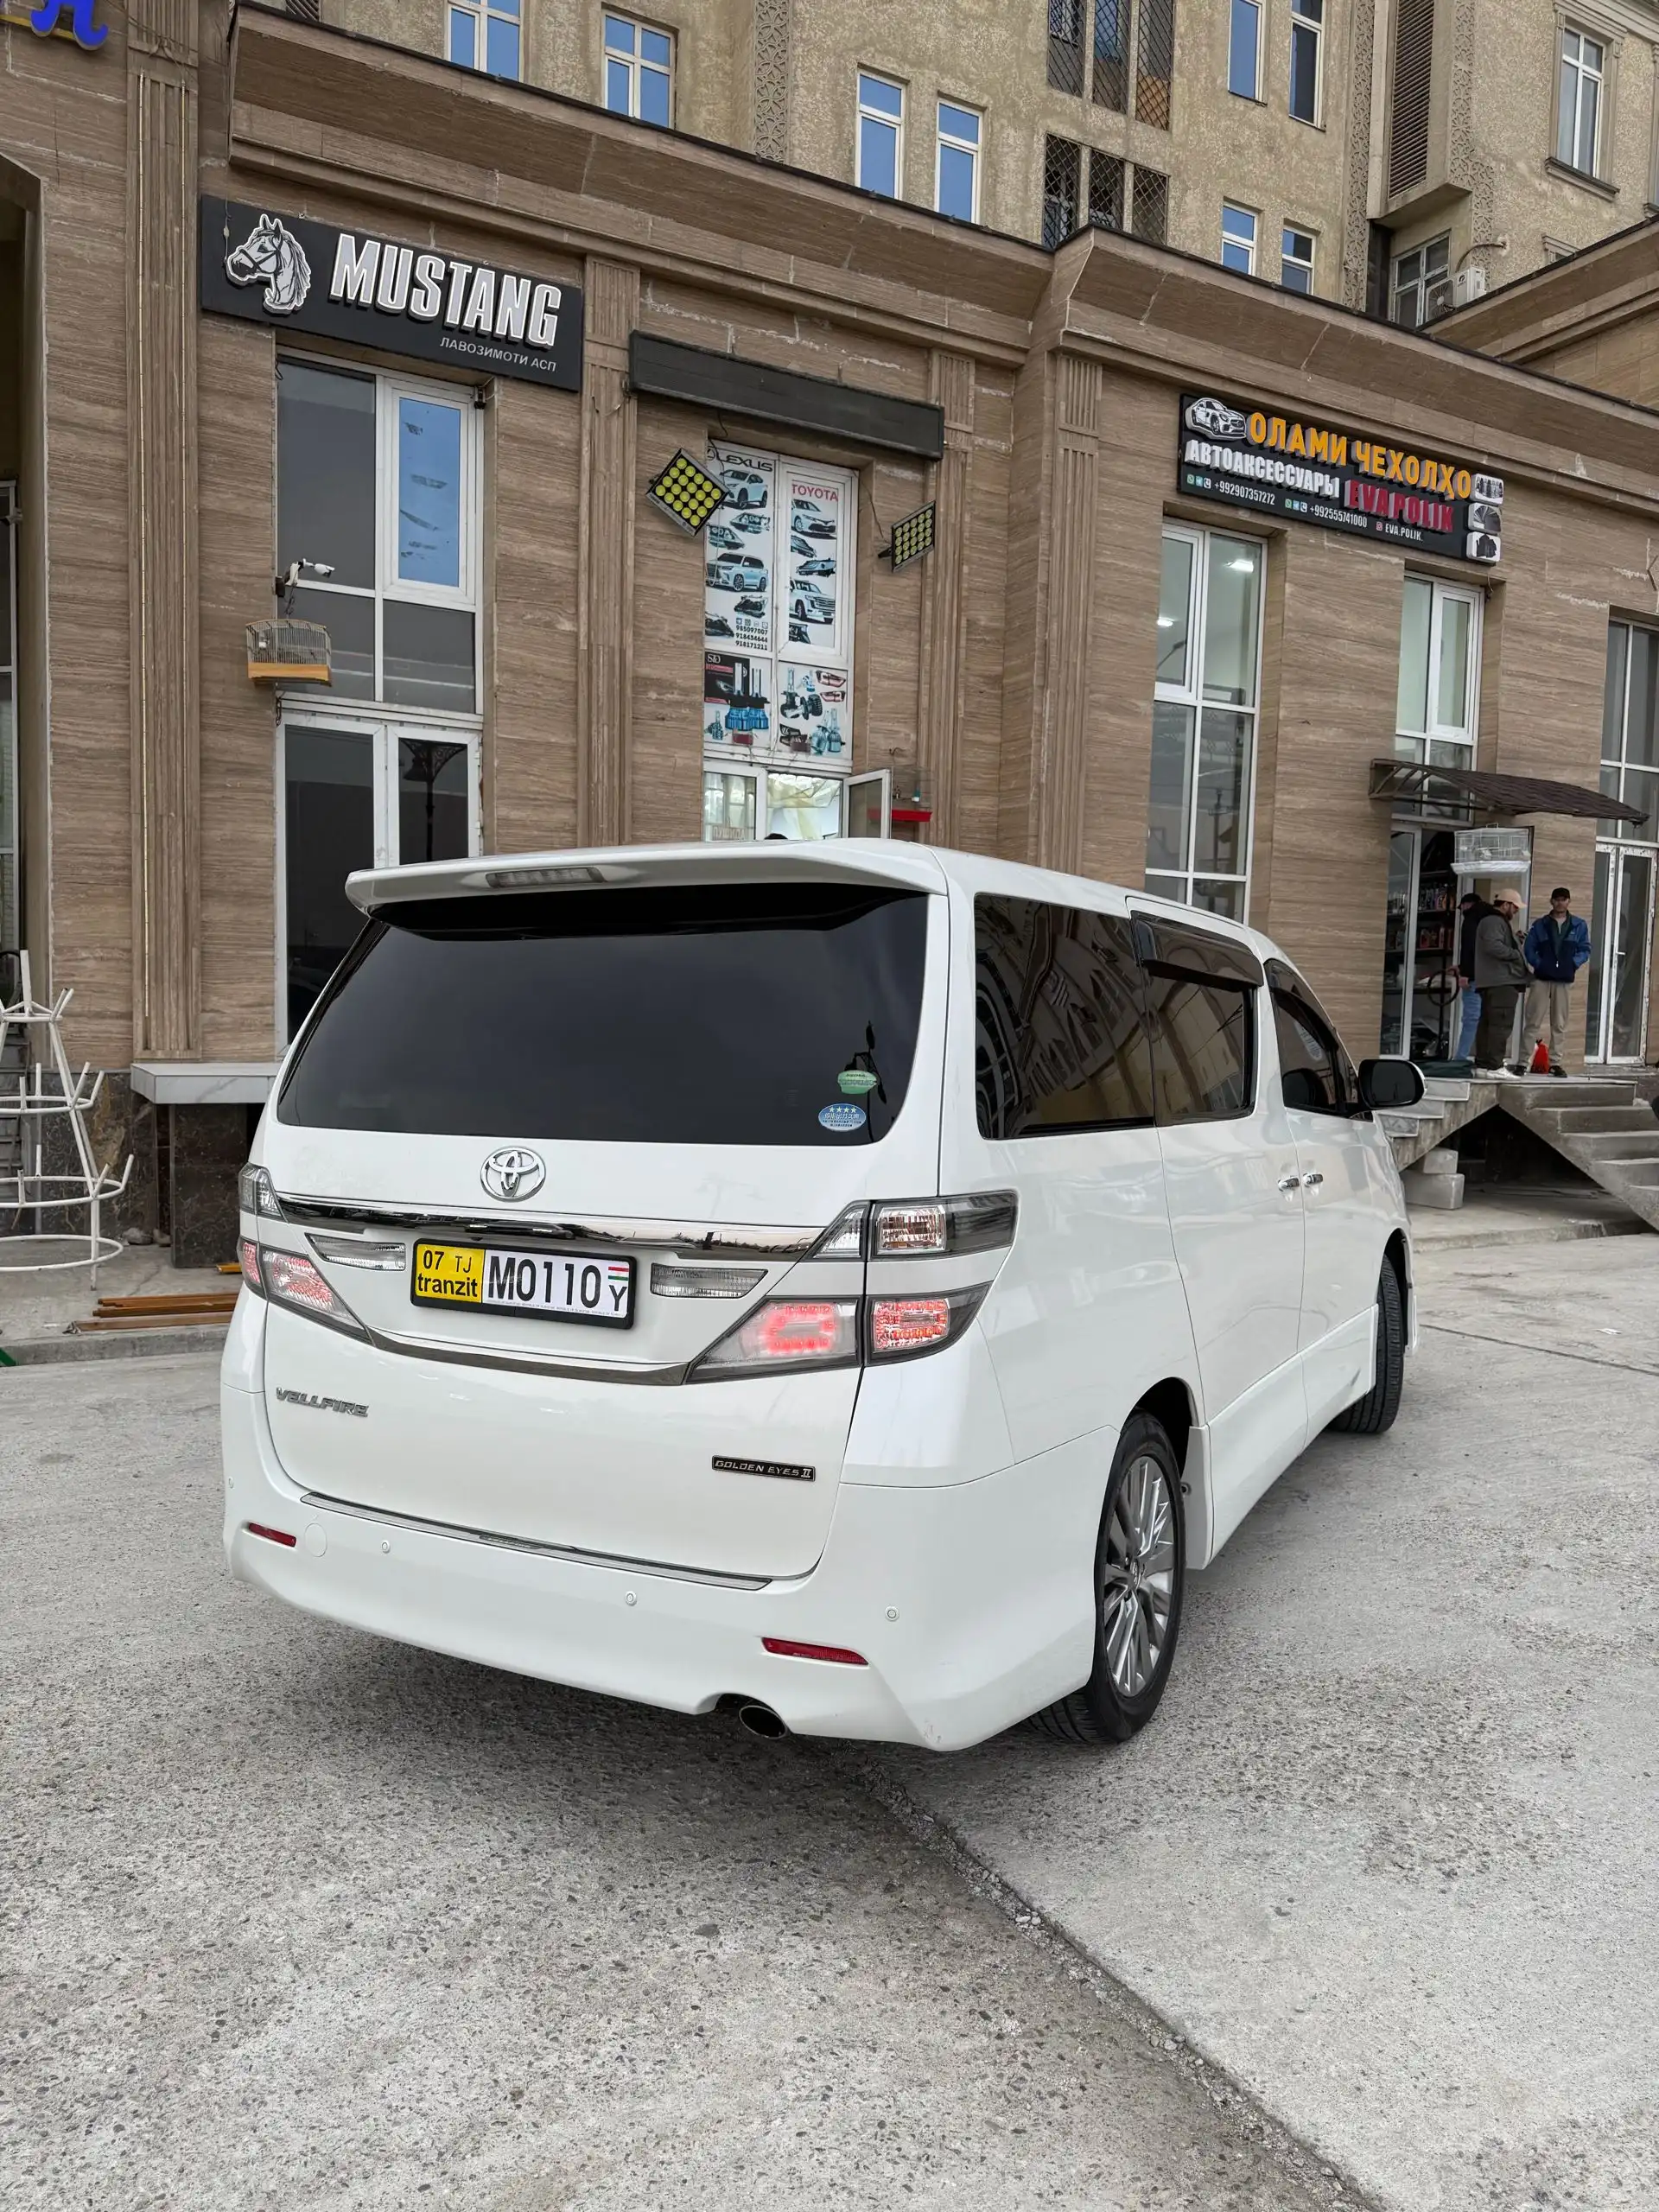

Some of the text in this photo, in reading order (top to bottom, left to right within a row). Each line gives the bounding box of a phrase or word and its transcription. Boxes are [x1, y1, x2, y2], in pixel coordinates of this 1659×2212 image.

[329, 232, 563, 349] MUSTANG
[440, 337, 556, 372] ЛАВОЗИМОТИ АСП
[1249, 411, 1347, 467] ОЛАМИ
[718, 452, 772, 472] LEXUS
[1185, 439, 1340, 499] АВТОАКСЕССУАРЫ
[791, 483, 838, 501] TOYOTA
[1214, 480, 1275, 505] +992907357272
[1309, 505, 1368, 528] +992555741000
[423, 1249, 473, 1273] 07 TJ
[417, 1271, 478, 1298] tranzit
[276, 1387, 369, 1418] VELLFIRE
[715, 1460, 765, 1472] GOLDEN
[767, 1465, 799, 1477] EYES
